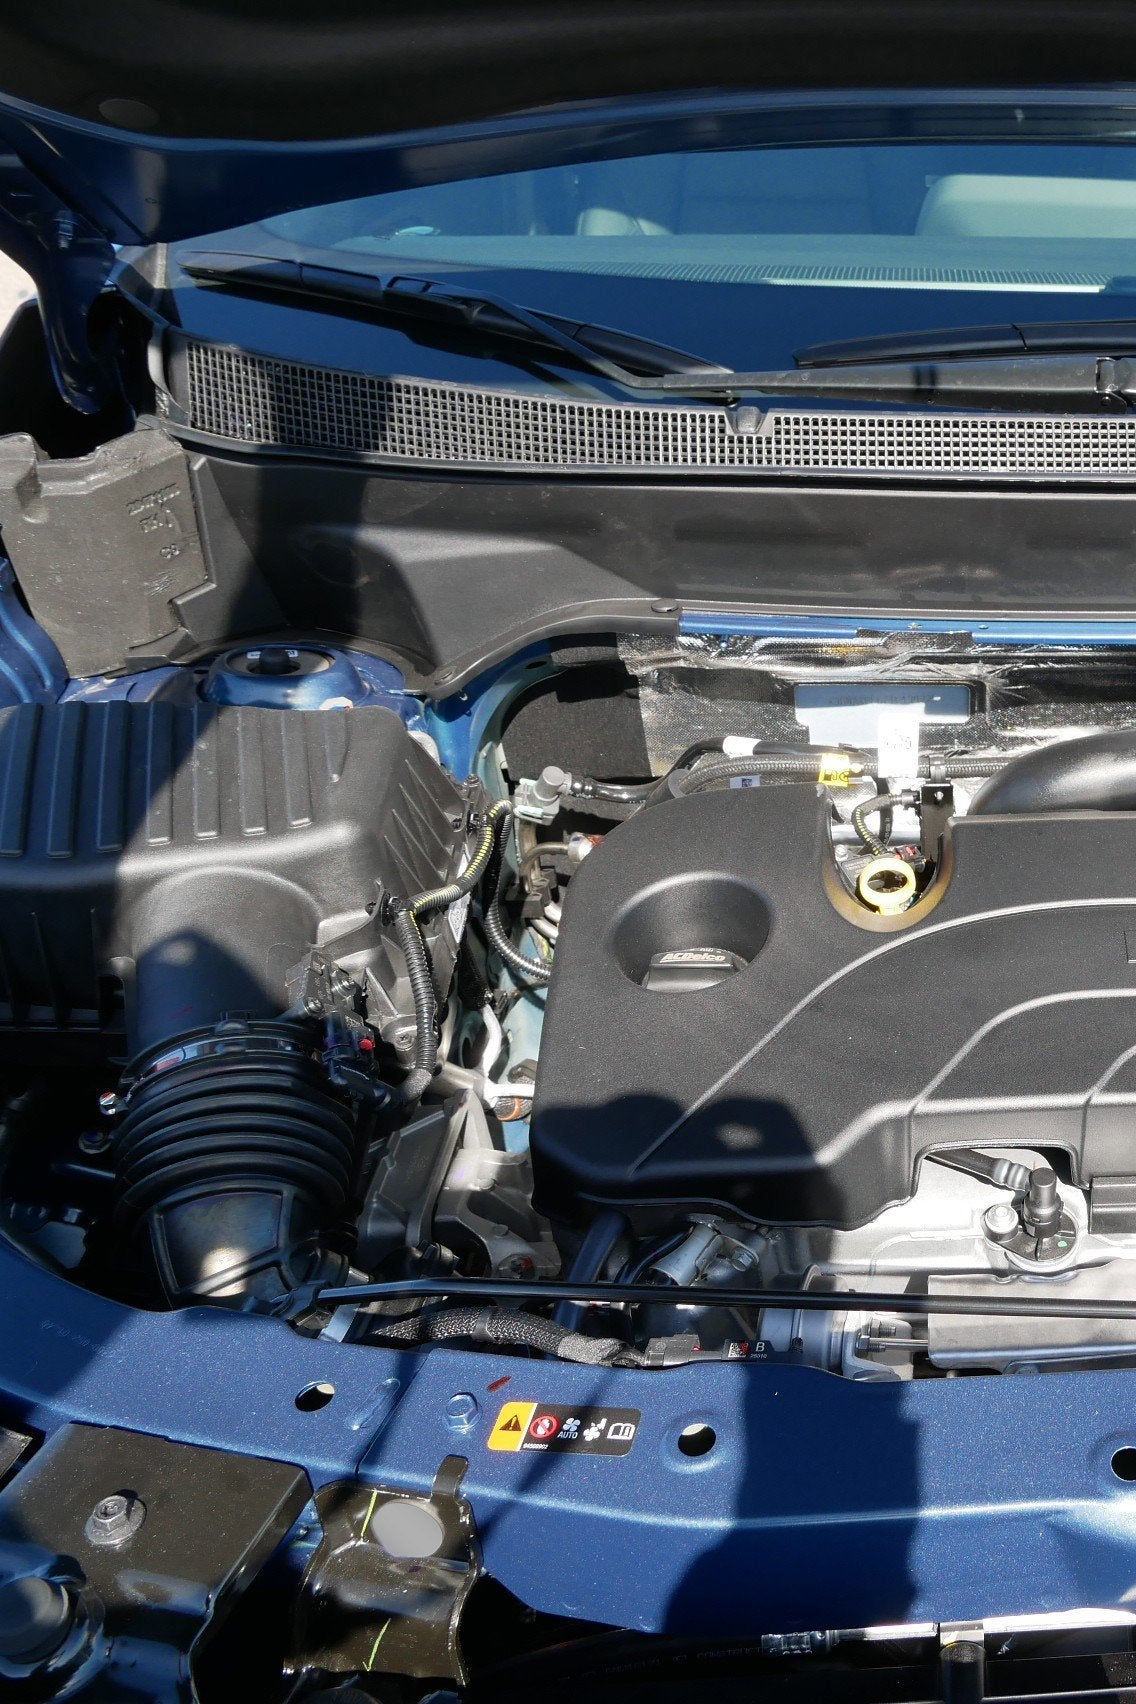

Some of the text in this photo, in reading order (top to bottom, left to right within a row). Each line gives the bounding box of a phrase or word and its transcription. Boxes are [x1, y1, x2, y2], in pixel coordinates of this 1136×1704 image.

[659, 952, 726, 963] ACDelco
[756, 1341, 765, 1352] B
[557, 1431, 579, 1439] AUTO
